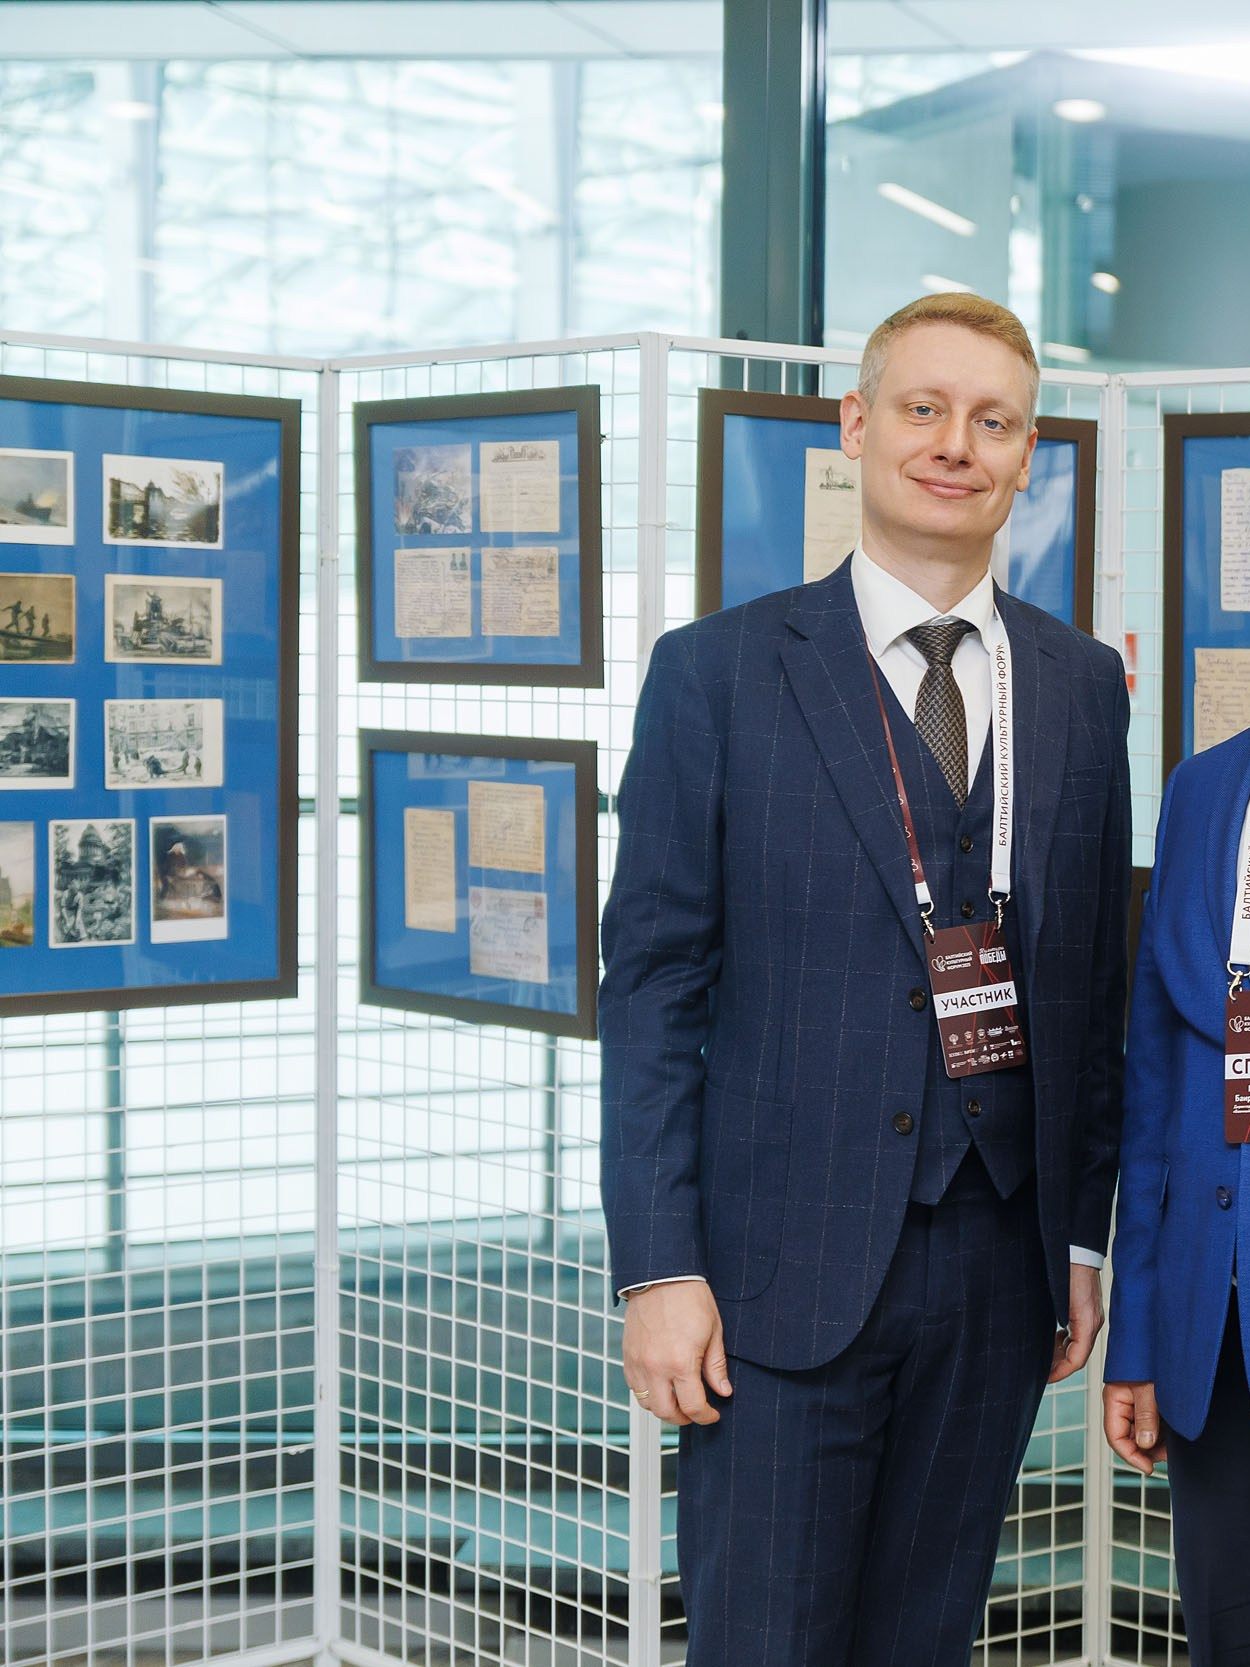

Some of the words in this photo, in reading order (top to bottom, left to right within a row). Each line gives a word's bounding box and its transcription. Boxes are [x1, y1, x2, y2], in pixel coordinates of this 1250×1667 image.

[997, 682, 1008, 760] КУЛЬТУРНЫЙ
[998, 763, 1008, 847] БАЛТИЙСКИЙ
[979, 950, 1007, 965] ПОБЕДЫ
[941, 988, 1013, 1011] УЧАСТНИК
